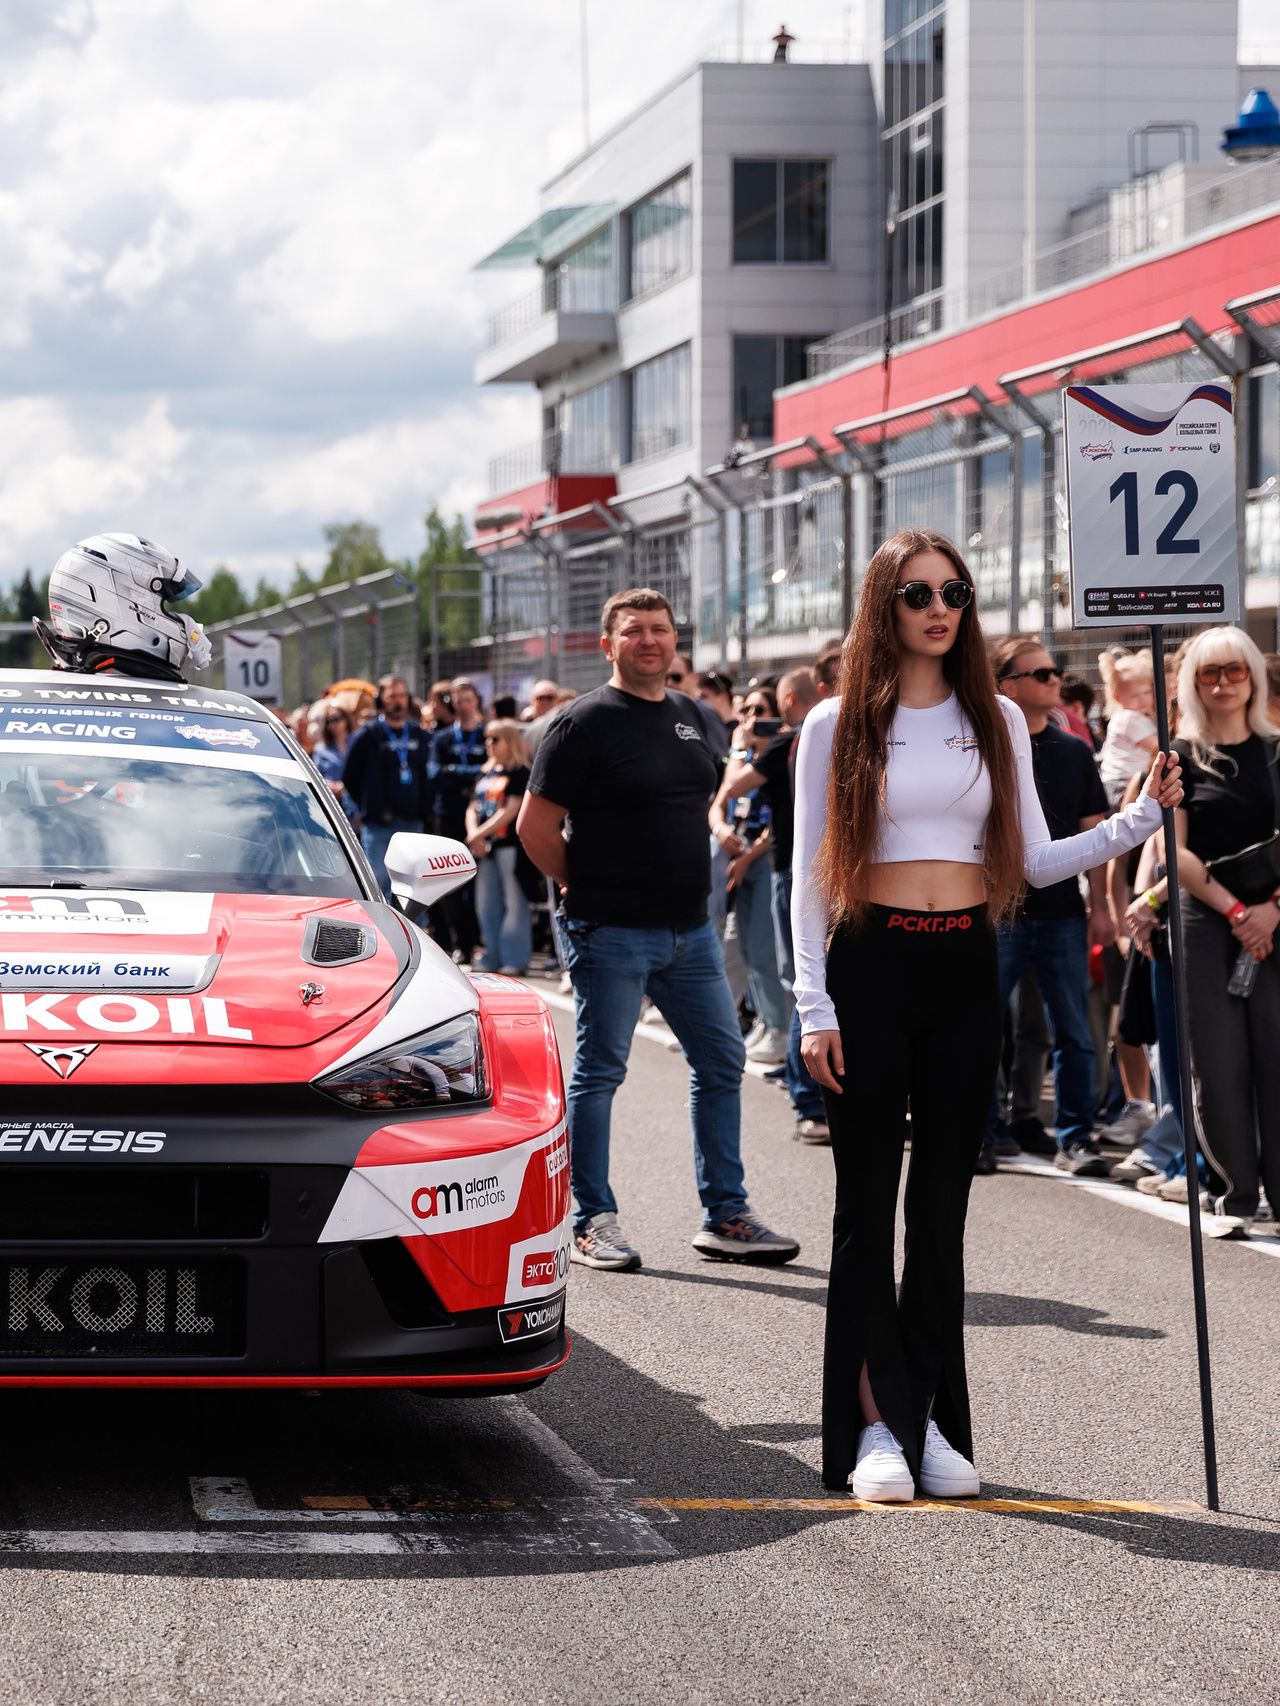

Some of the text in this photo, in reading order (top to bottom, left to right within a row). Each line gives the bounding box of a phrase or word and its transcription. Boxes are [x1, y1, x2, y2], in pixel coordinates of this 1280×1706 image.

[1109, 469, 1201, 556] 12
[239, 659, 270, 688] 10
[34, 688, 152, 703] TWINS
[161, 695, 257, 716] TEAM
[10, 707, 123, 718] кольцевых
[129, 711, 186, 723] гонок
[4, 721, 137, 740] RACING
[427, 852, 470, 871] LUKOIL
[886, 913, 973, 933] РСКГ.РФ
[114, 961, 170, 978] банк
[35, 1122, 75, 1130] МАСЛА
[465, 1175, 499, 1195] alarm
[411, 1181, 464, 1219] am
[465, 1189, 506, 1211] motors
[526, 1262, 555, 1279] ЭКТО
